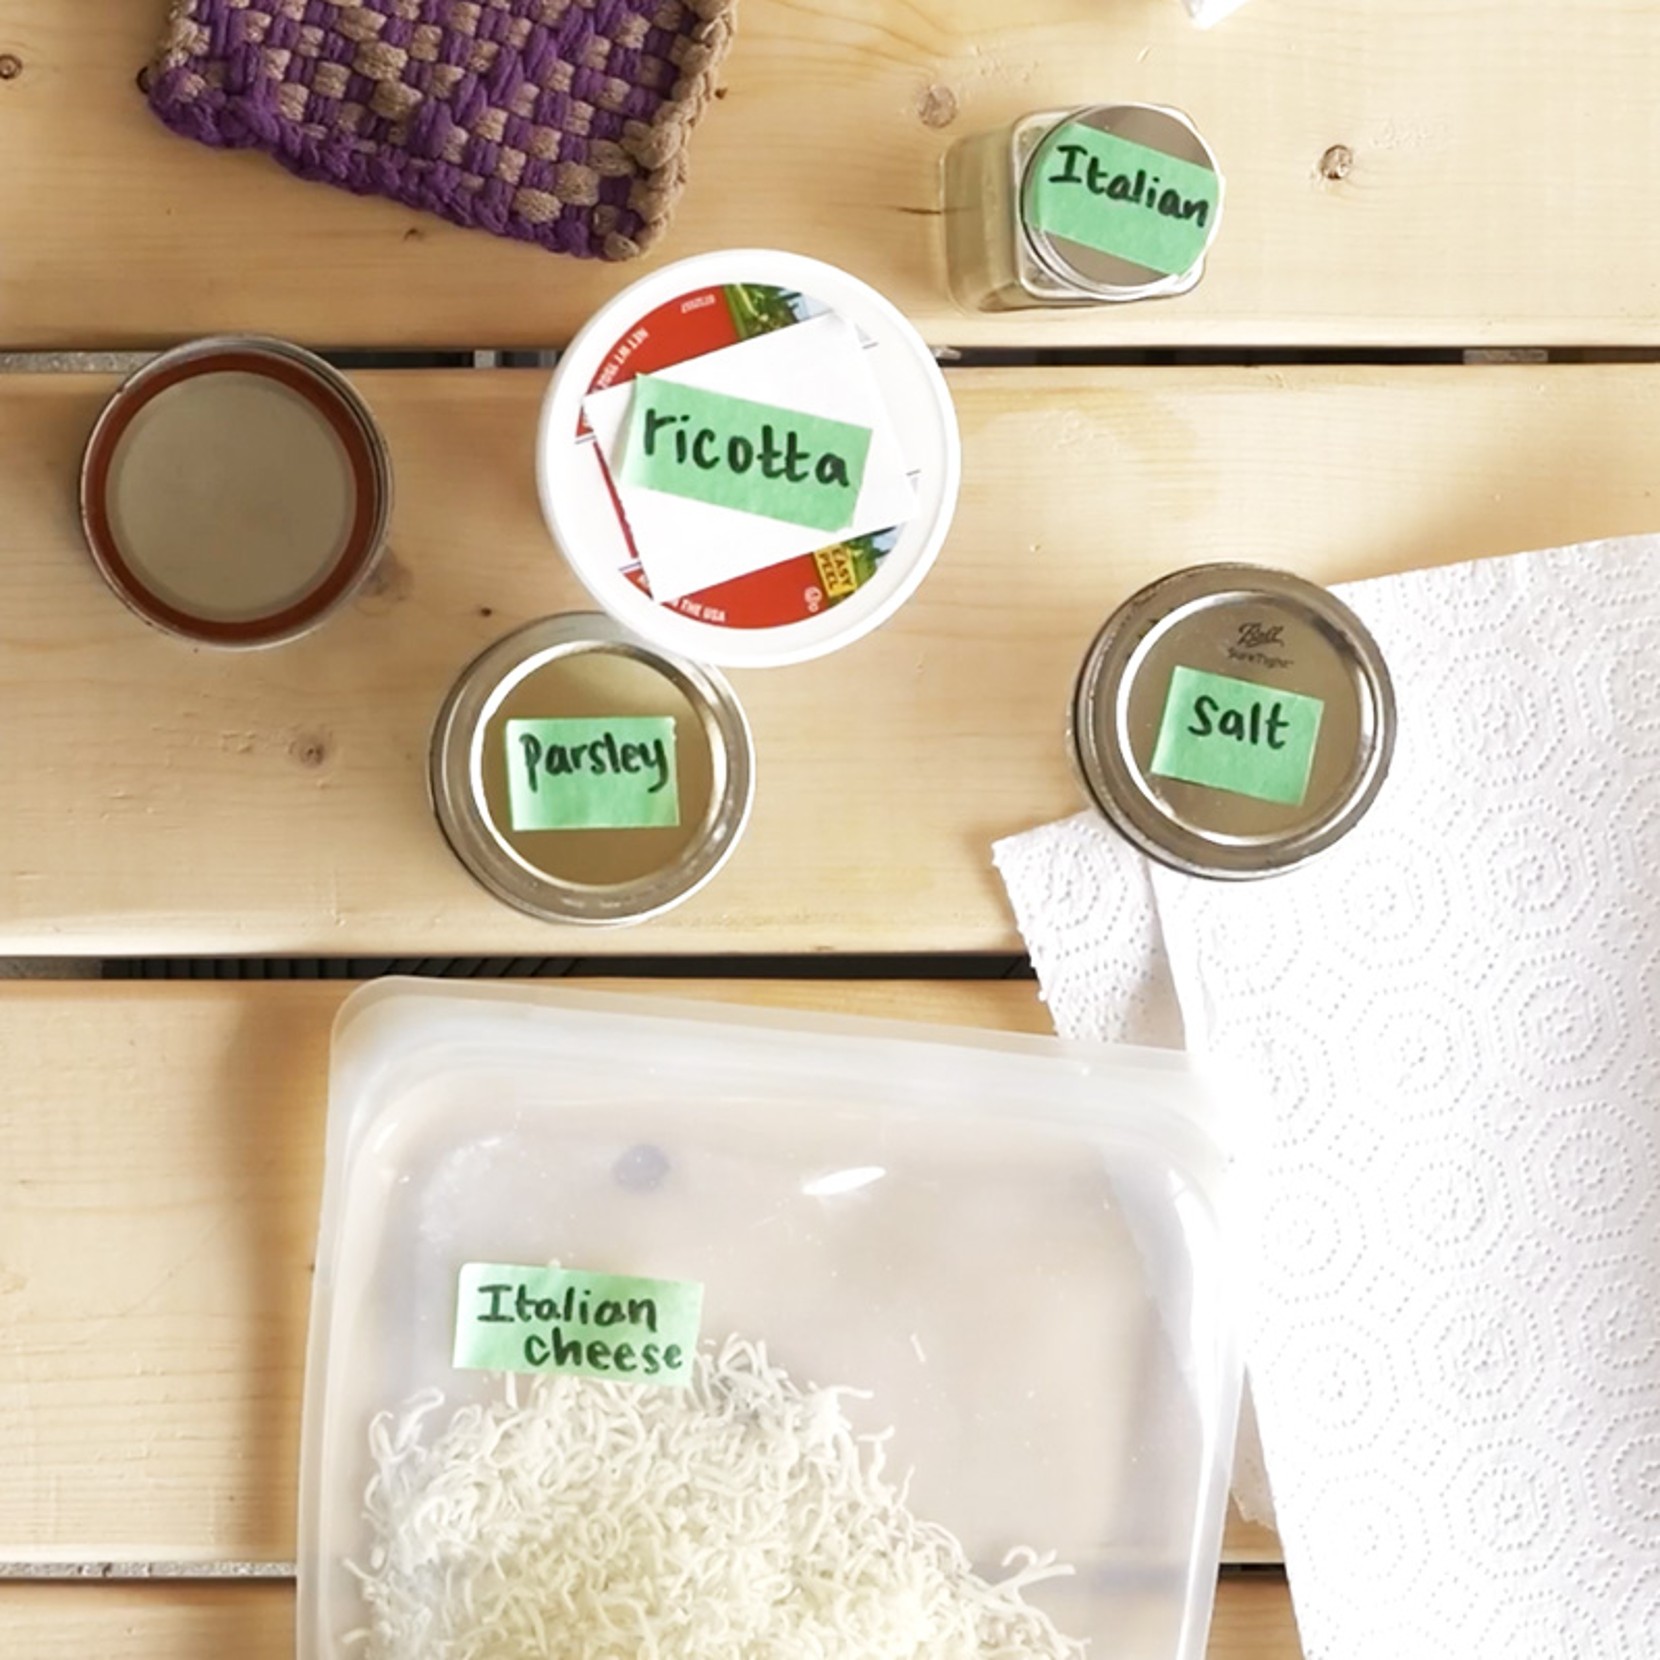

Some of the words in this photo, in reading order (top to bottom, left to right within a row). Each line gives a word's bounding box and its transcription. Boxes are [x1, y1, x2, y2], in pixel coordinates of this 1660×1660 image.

[1048, 144, 1209, 228] Italian
[643, 409, 850, 488] ricotta
[818, 552, 838, 591] PEEL
[831, 547, 853, 586] EASY
[702, 605, 726, 622] USA
[1237, 622, 1285, 648] Ball
[477, 1284, 657, 1332] Italian
[524, 1326, 683, 1374] cheese
